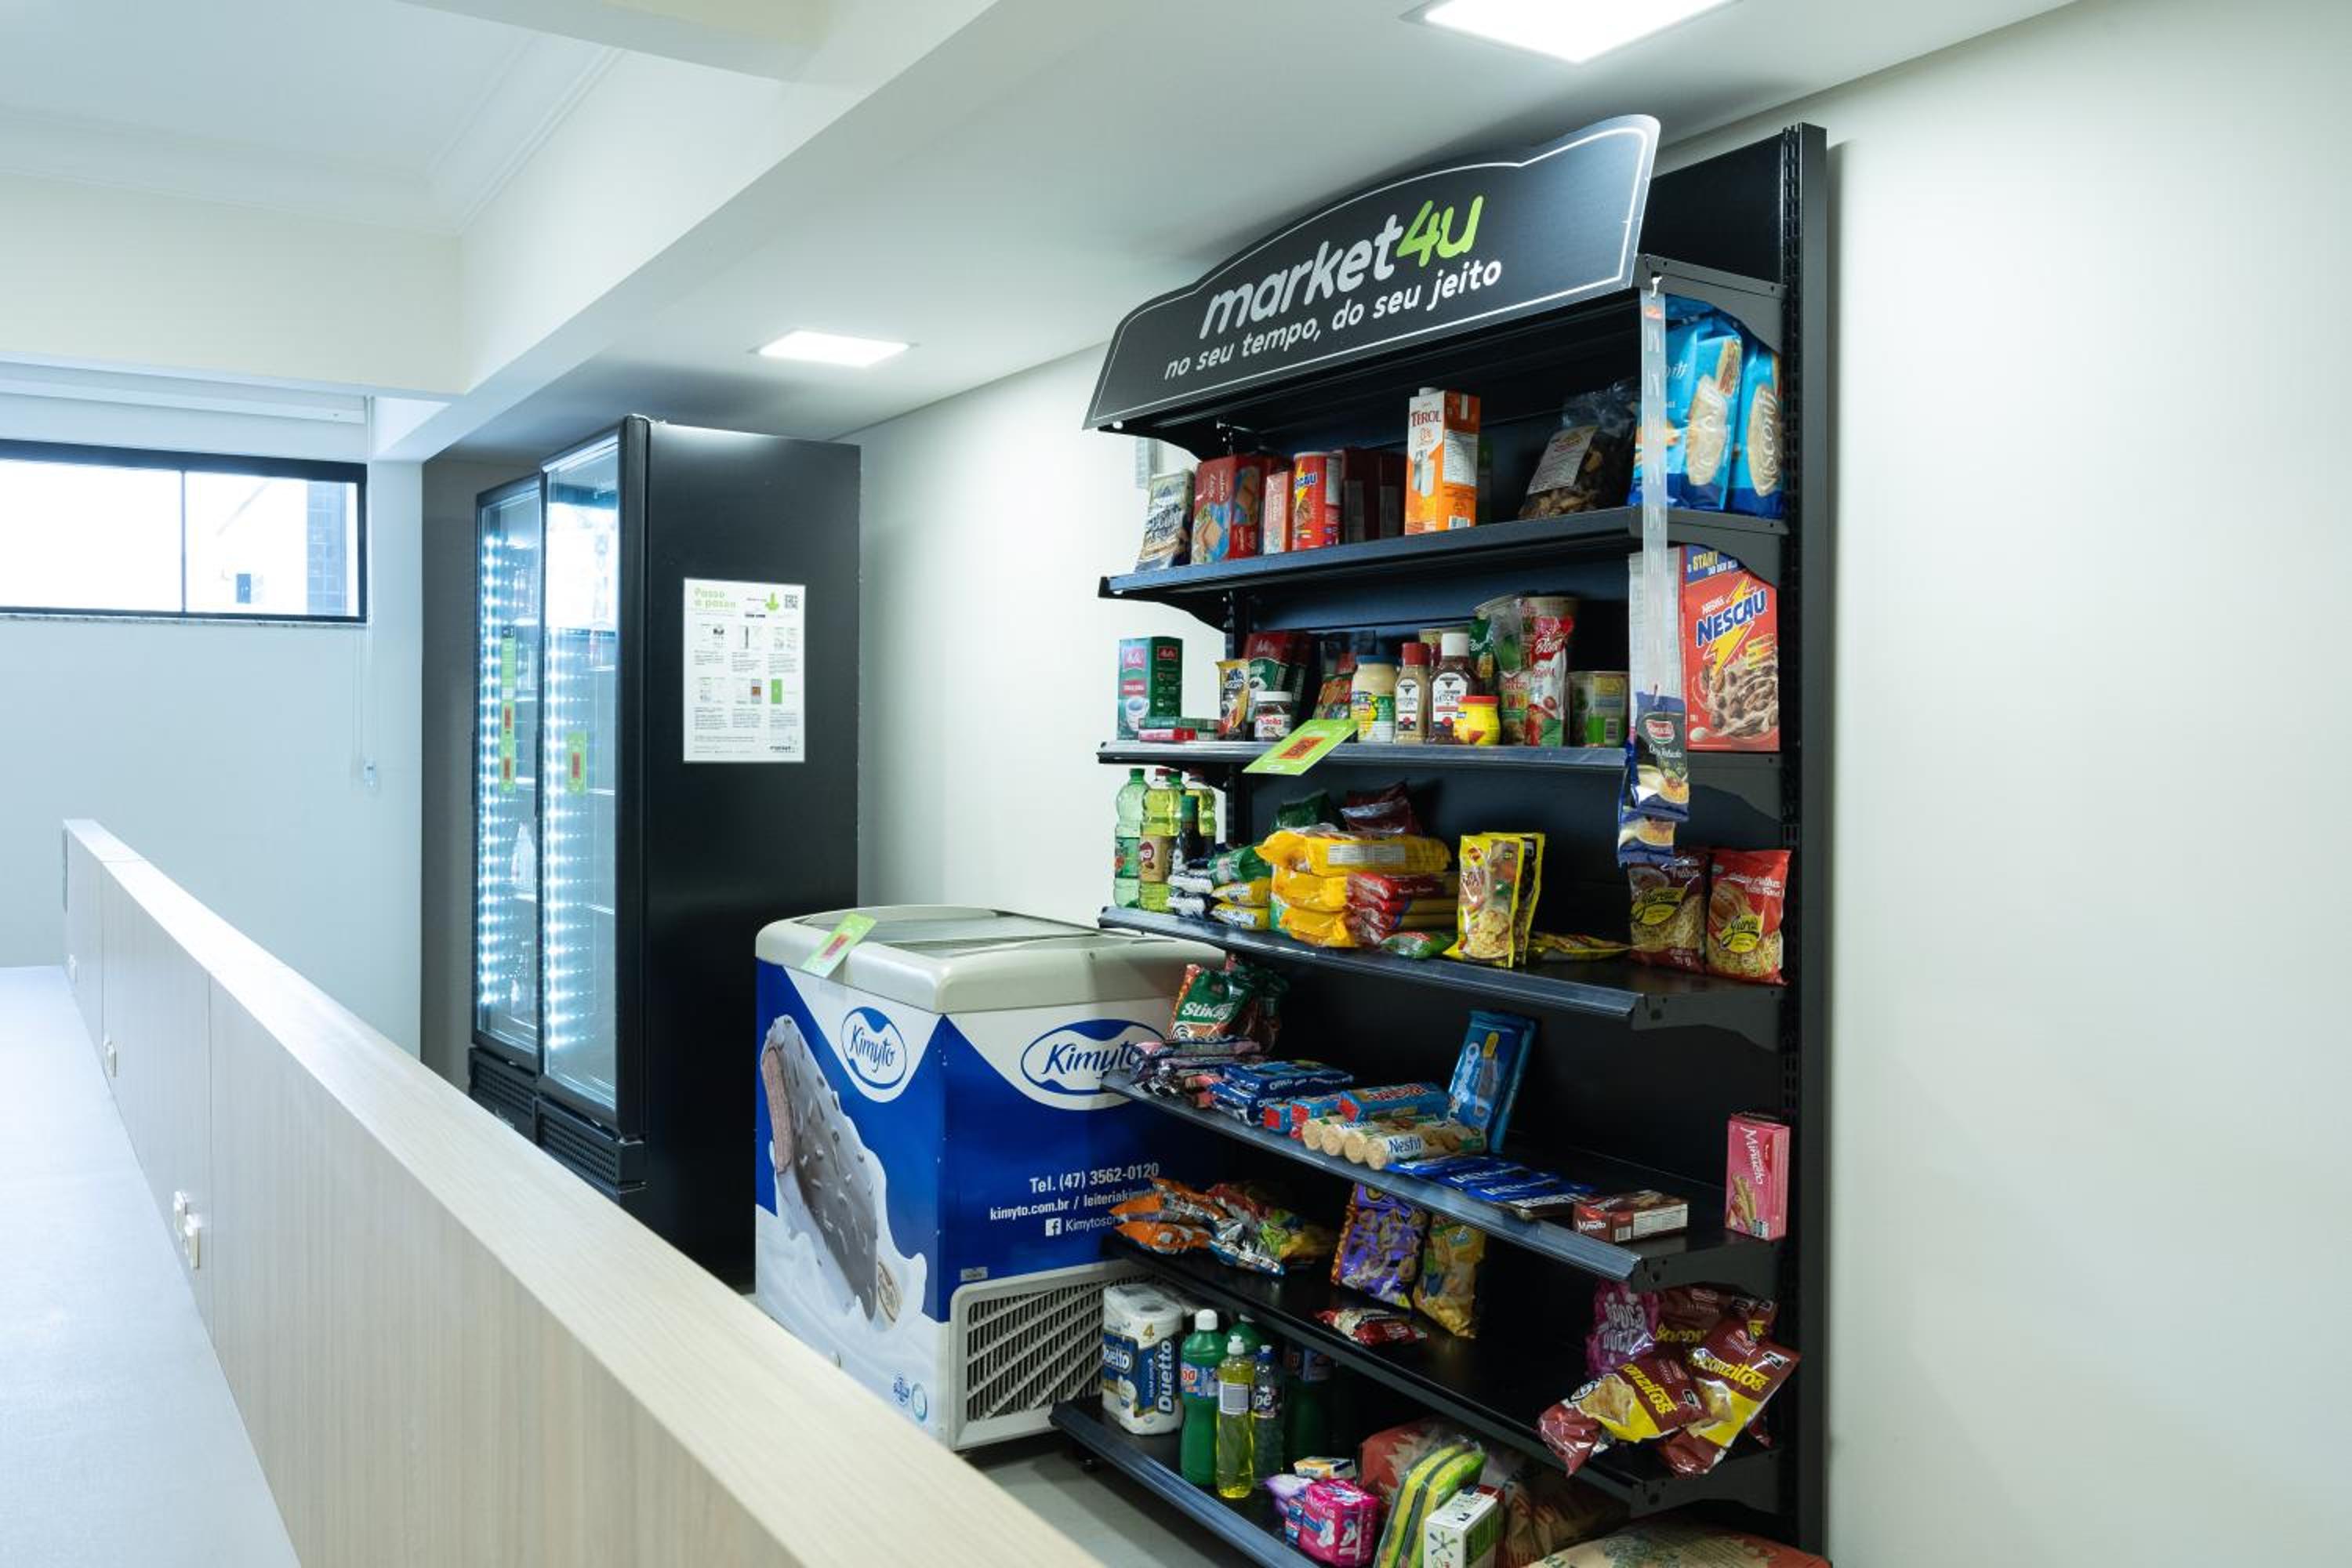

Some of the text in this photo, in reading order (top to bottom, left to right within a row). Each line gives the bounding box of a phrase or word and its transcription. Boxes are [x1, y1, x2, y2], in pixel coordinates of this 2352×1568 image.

[1164, 259, 1503, 380] no seu tempo, do seu jeito
[1696, 588, 1767, 648] NESCAU
[849, 1024, 895, 1074] Kimyto
[1042, 1040, 1139, 1083] Kimyto
[1029, 1163, 1160, 1193] Tel. (47) 3562-0120
[990, 1199, 1069, 1221] kimyto.com.br
[1142, 1323, 1155, 1340] 4
[1158, 1340, 1172, 1413] Duetto
